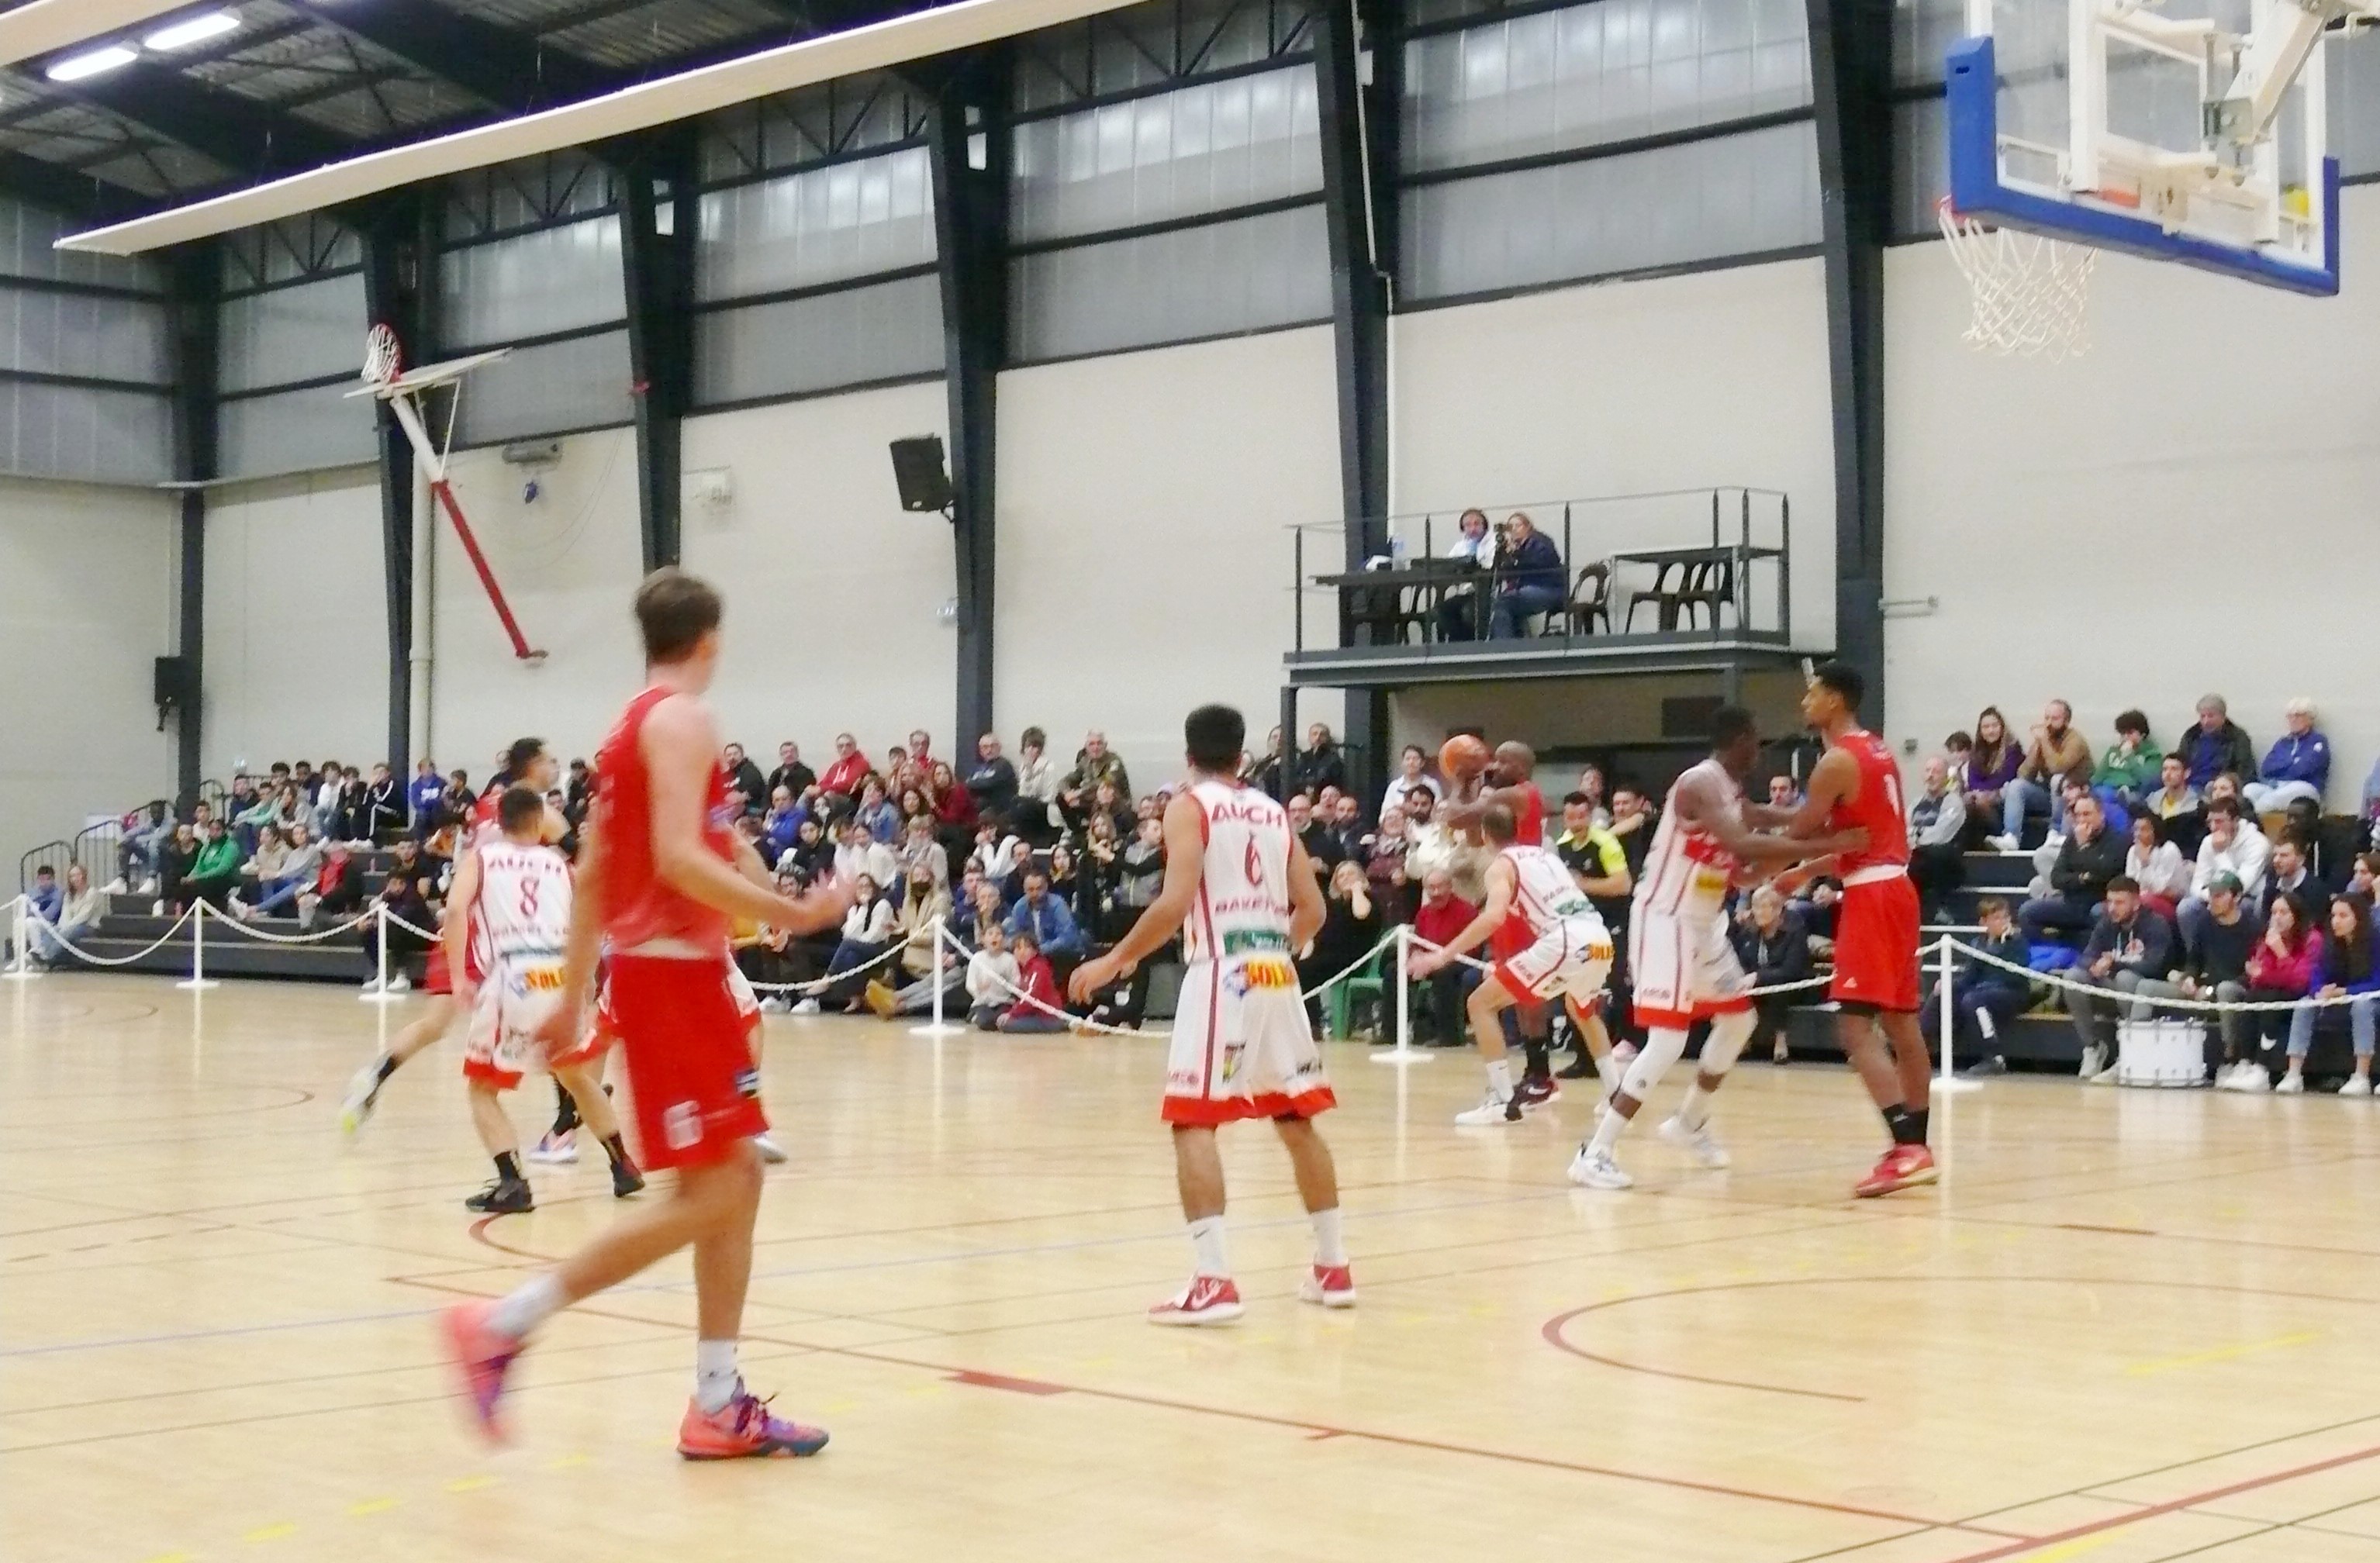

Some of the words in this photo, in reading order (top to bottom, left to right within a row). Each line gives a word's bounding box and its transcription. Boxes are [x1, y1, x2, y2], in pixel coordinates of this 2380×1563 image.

[1212, 803, 1283, 829] AUCH
[1244, 831, 1263, 887] 6
[520, 877, 540, 916] 8
